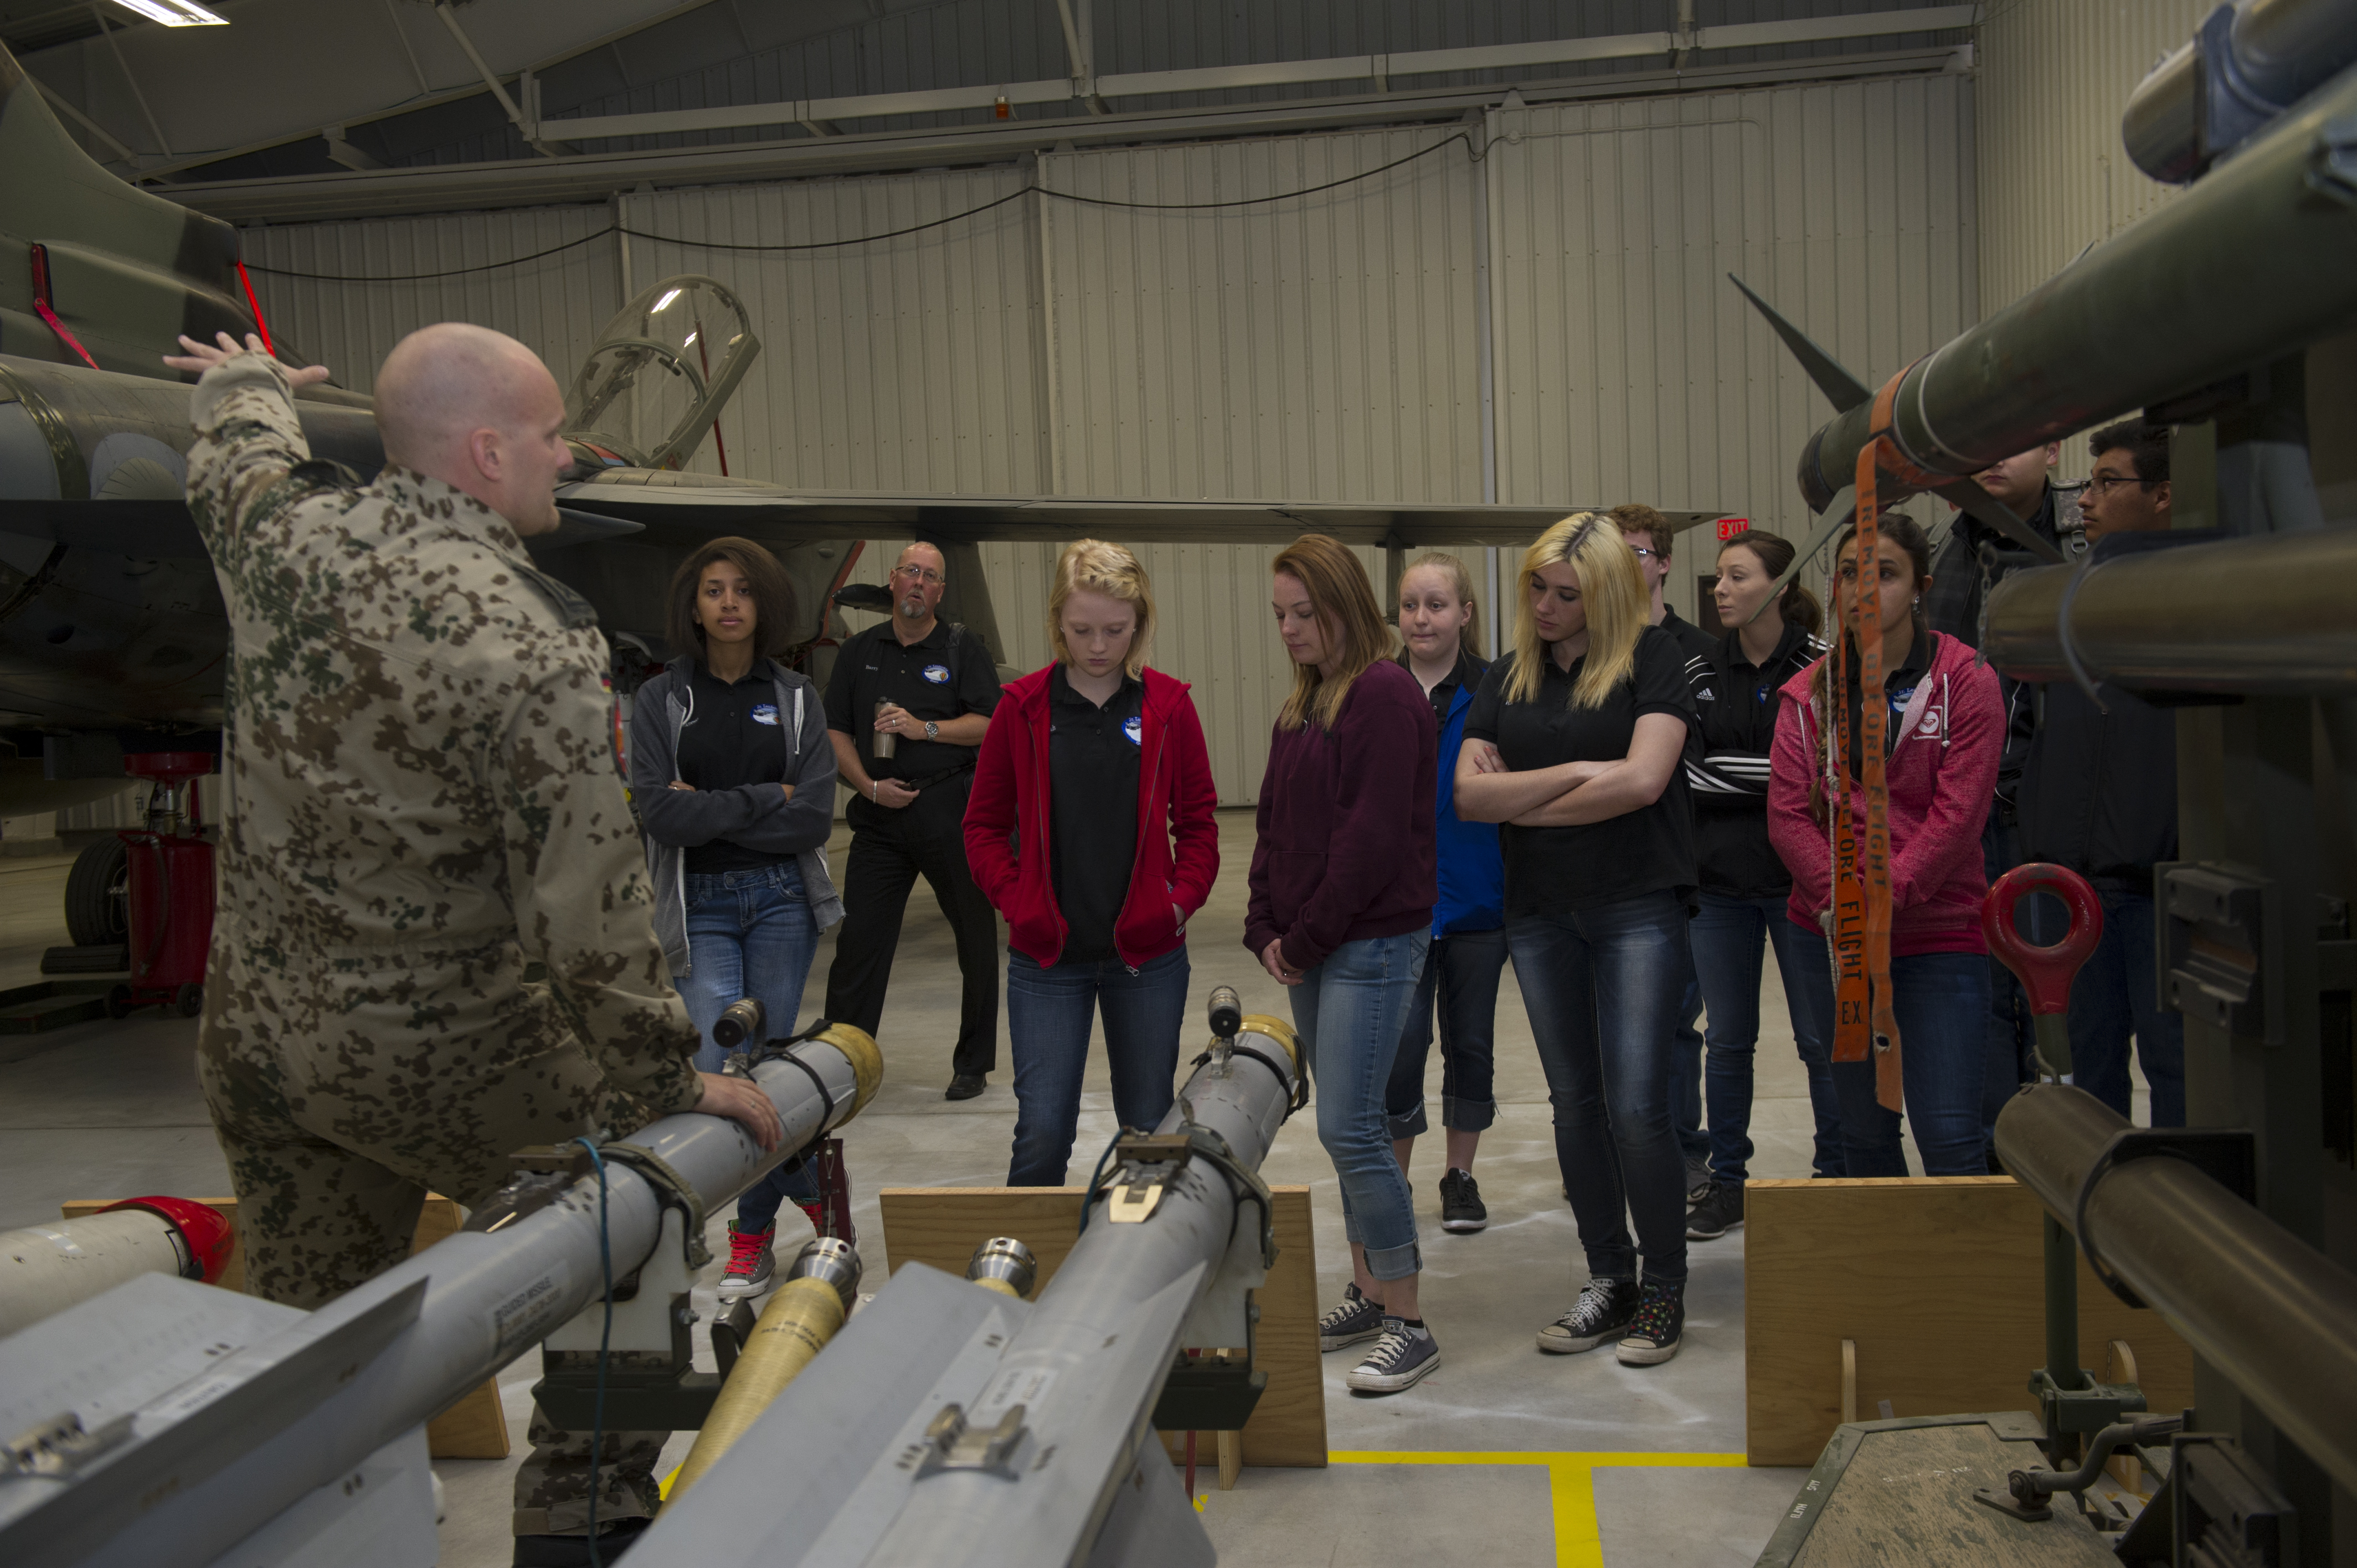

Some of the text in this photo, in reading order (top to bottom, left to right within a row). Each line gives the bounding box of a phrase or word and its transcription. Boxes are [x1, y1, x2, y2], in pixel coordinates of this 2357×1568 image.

[1718, 521, 1747, 538] EXIT
[1862, 504, 1887, 889] REMOVE BEFORE FLIGHT
[1837, 676, 1862, 981] REMOVE BEFORE FLIGHT
[1841, 1000, 1861, 1025] EX
